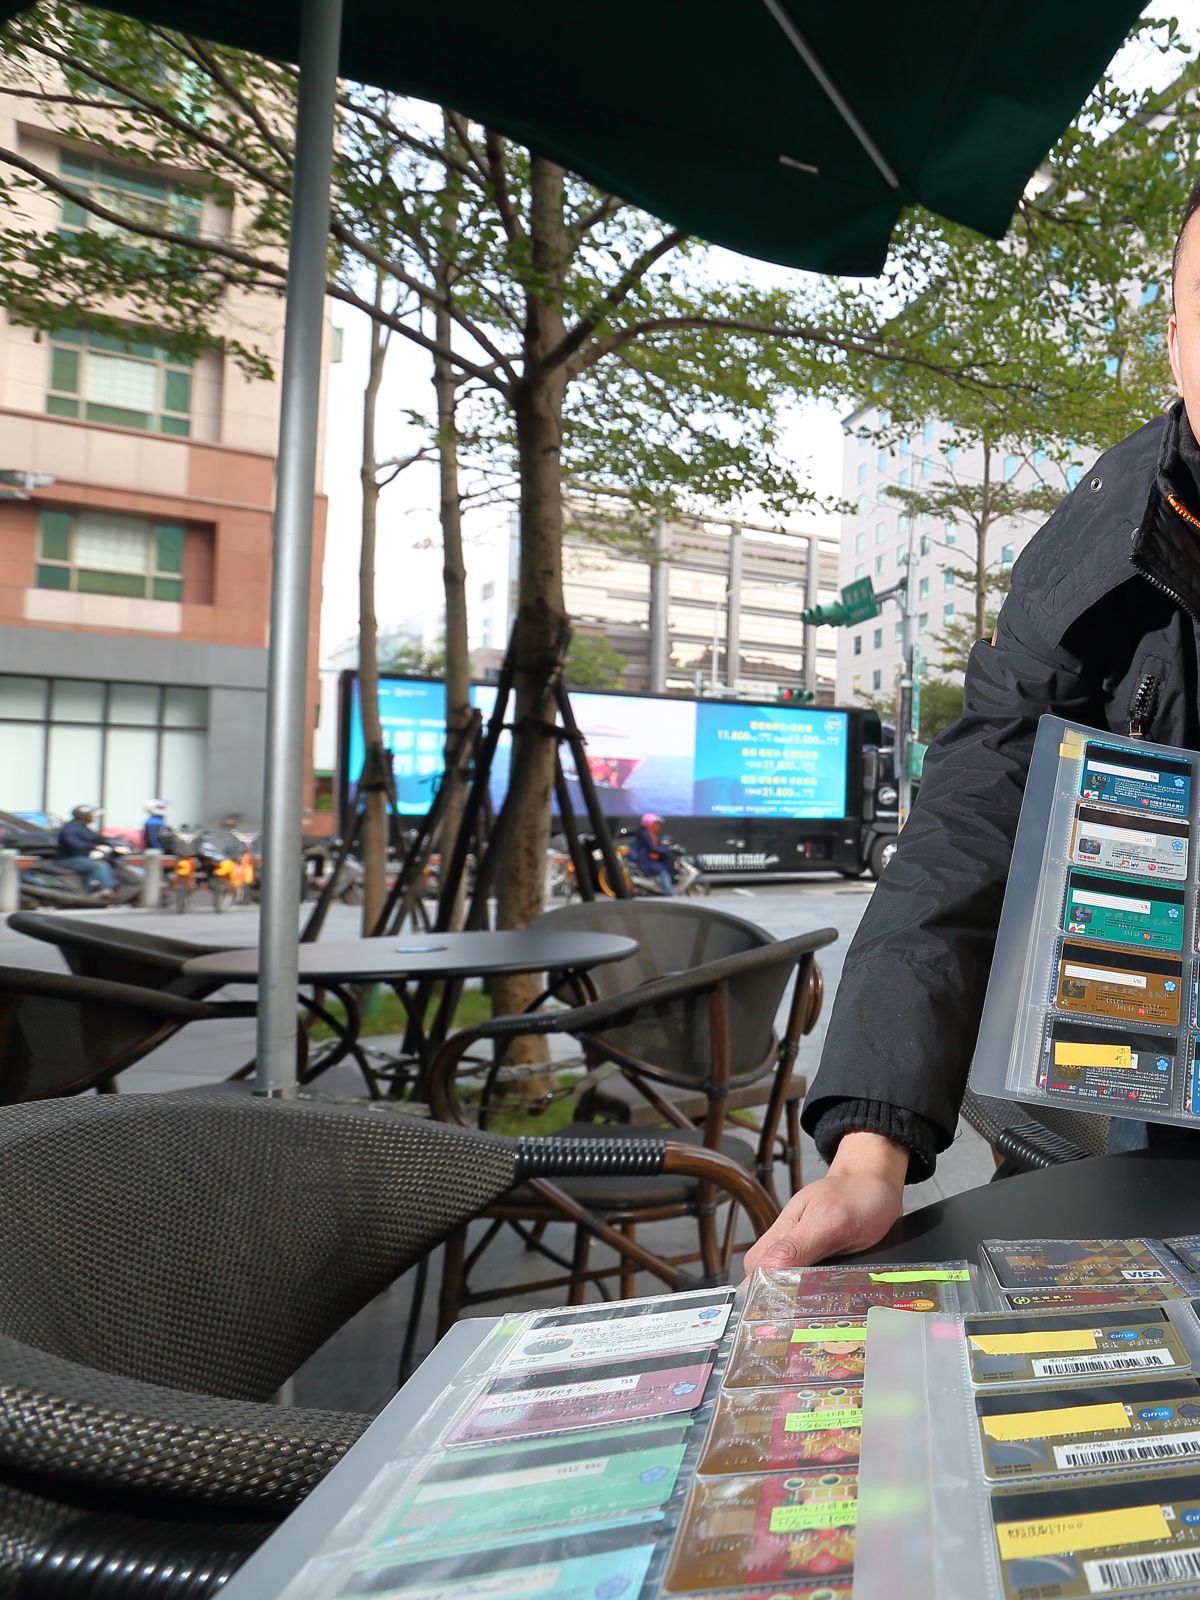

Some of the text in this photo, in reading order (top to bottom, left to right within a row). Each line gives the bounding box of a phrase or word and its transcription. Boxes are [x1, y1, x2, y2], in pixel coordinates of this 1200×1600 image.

[1127, 1270, 1164, 1279] VISA
[1110, 1332, 1135, 1340] Cirrus
[1142, 1409, 1169, 1418] Cirrus
